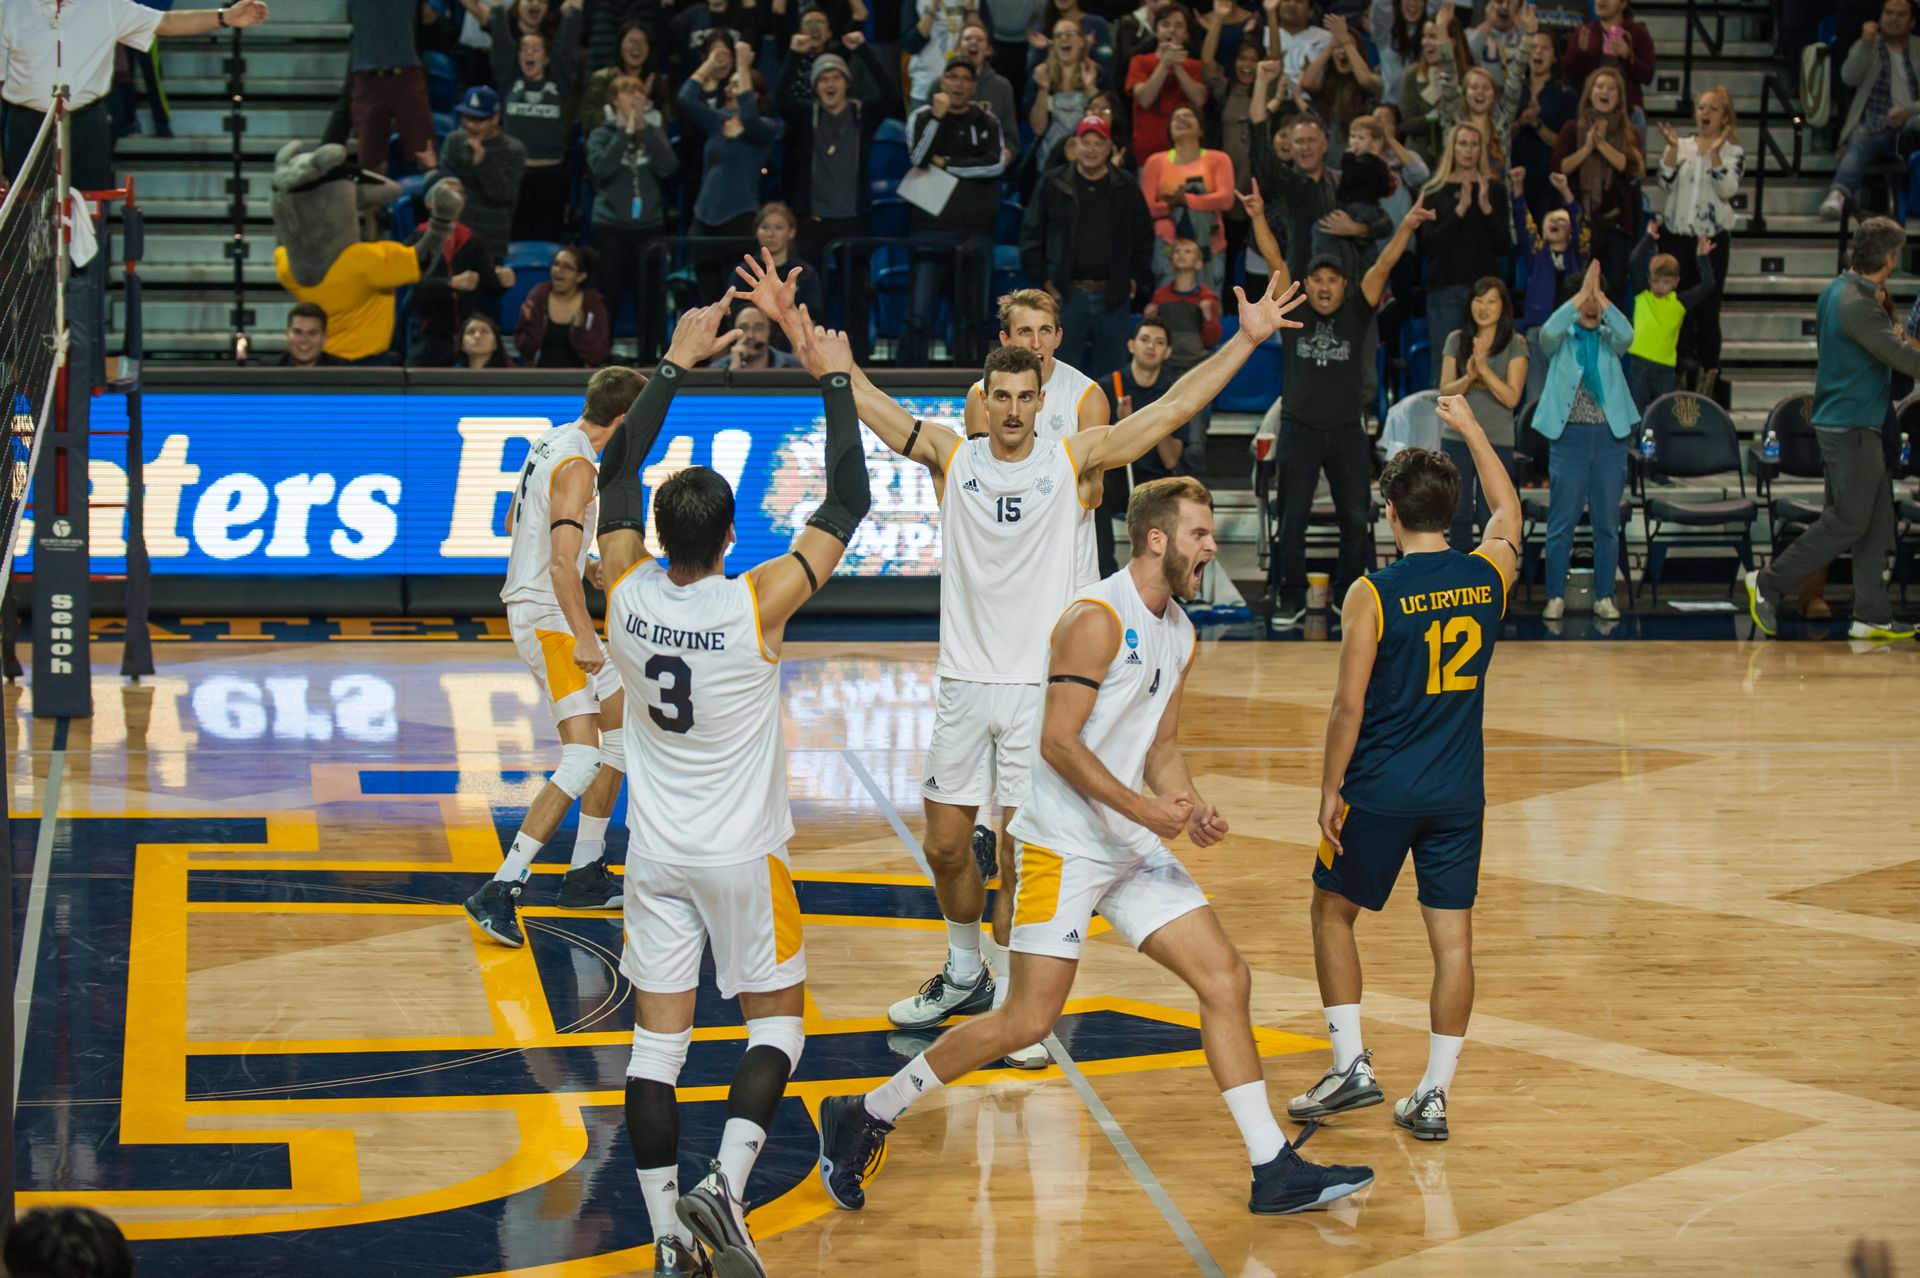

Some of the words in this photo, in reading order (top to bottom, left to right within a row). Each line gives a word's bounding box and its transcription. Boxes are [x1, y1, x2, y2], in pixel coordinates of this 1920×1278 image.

[996, 496, 1022, 523] 15
[1400, 593, 1428, 615] UC
[1429, 585, 1492, 610] IRVINE
[625, 613, 647, 640] UC
[652, 624, 725, 651] IRVINE
[1424, 615, 1482, 695] 12
[645, 653, 695, 734] 3
[1149, 668, 1160, 697] 4
